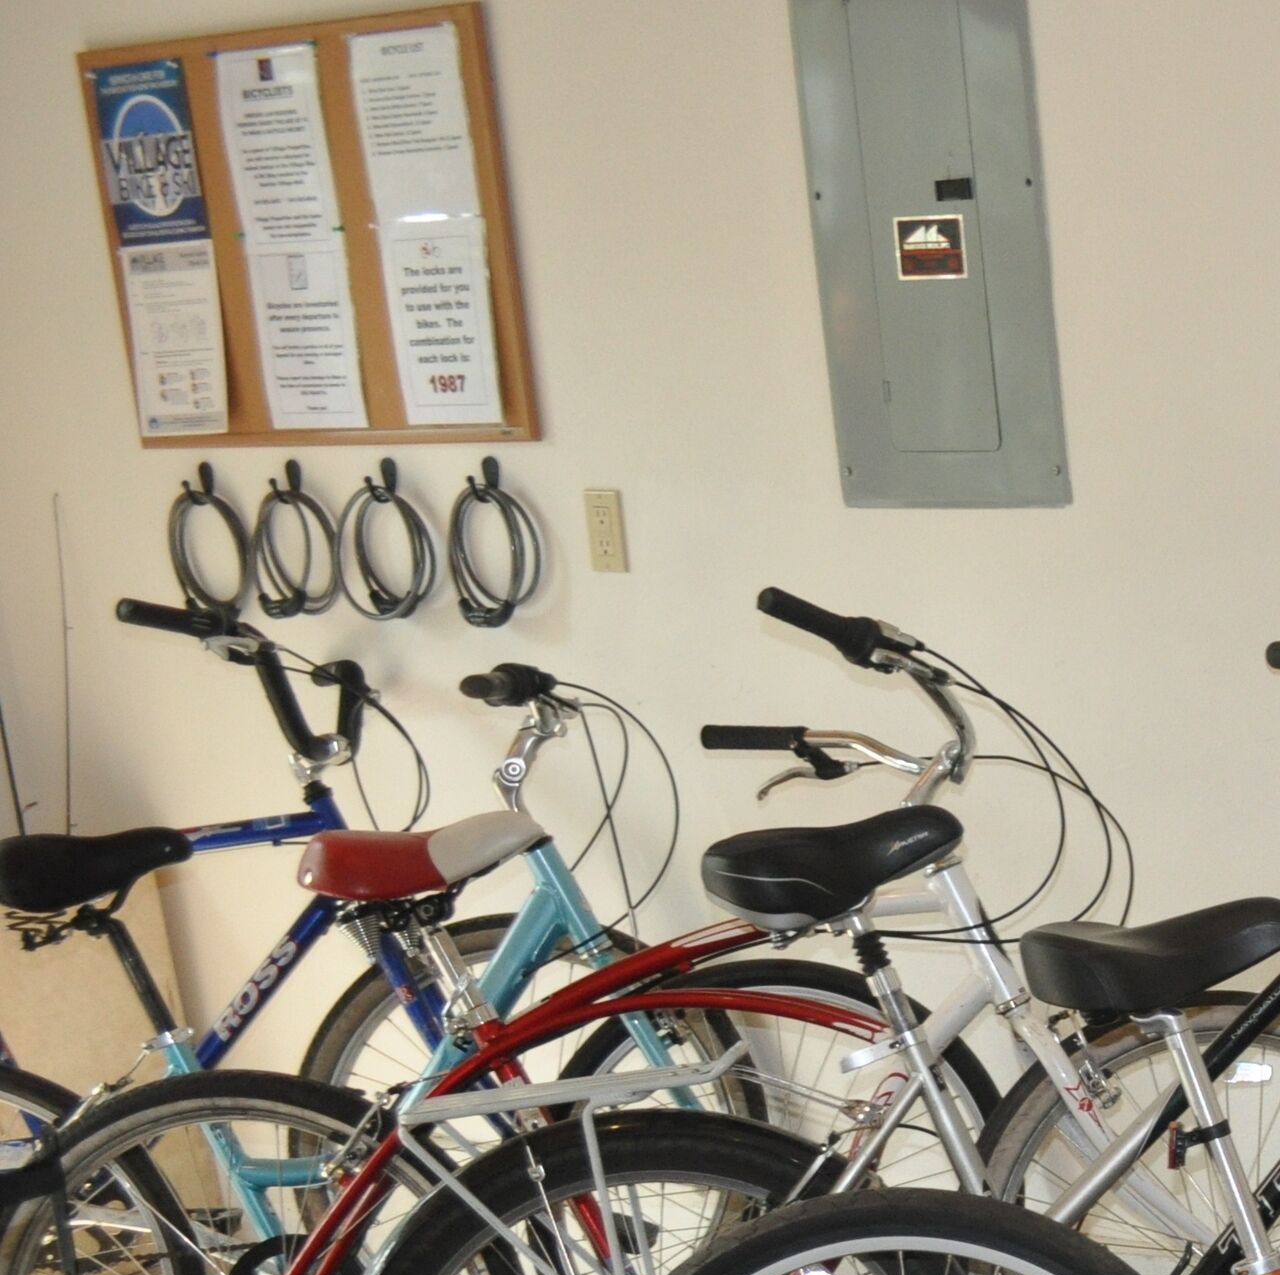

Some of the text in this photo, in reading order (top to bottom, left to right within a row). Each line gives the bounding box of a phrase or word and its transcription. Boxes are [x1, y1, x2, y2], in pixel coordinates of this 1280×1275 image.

[105, 134, 193, 175] VILLAGE
[404, 266, 463, 276] The locks are
[401, 283, 470, 296] provided for you
[405, 303, 414, 311] to
[434, 302, 453, 310] with
[455, 301, 470, 309] the
[446, 318, 463, 327] The
[409, 335, 475, 346] combination for
[418, 355, 438, 363] each
[440, 354, 458, 362] lock
[429, 374, 466, 393] 1987
[213, 935, 297, 1042] ROSS
